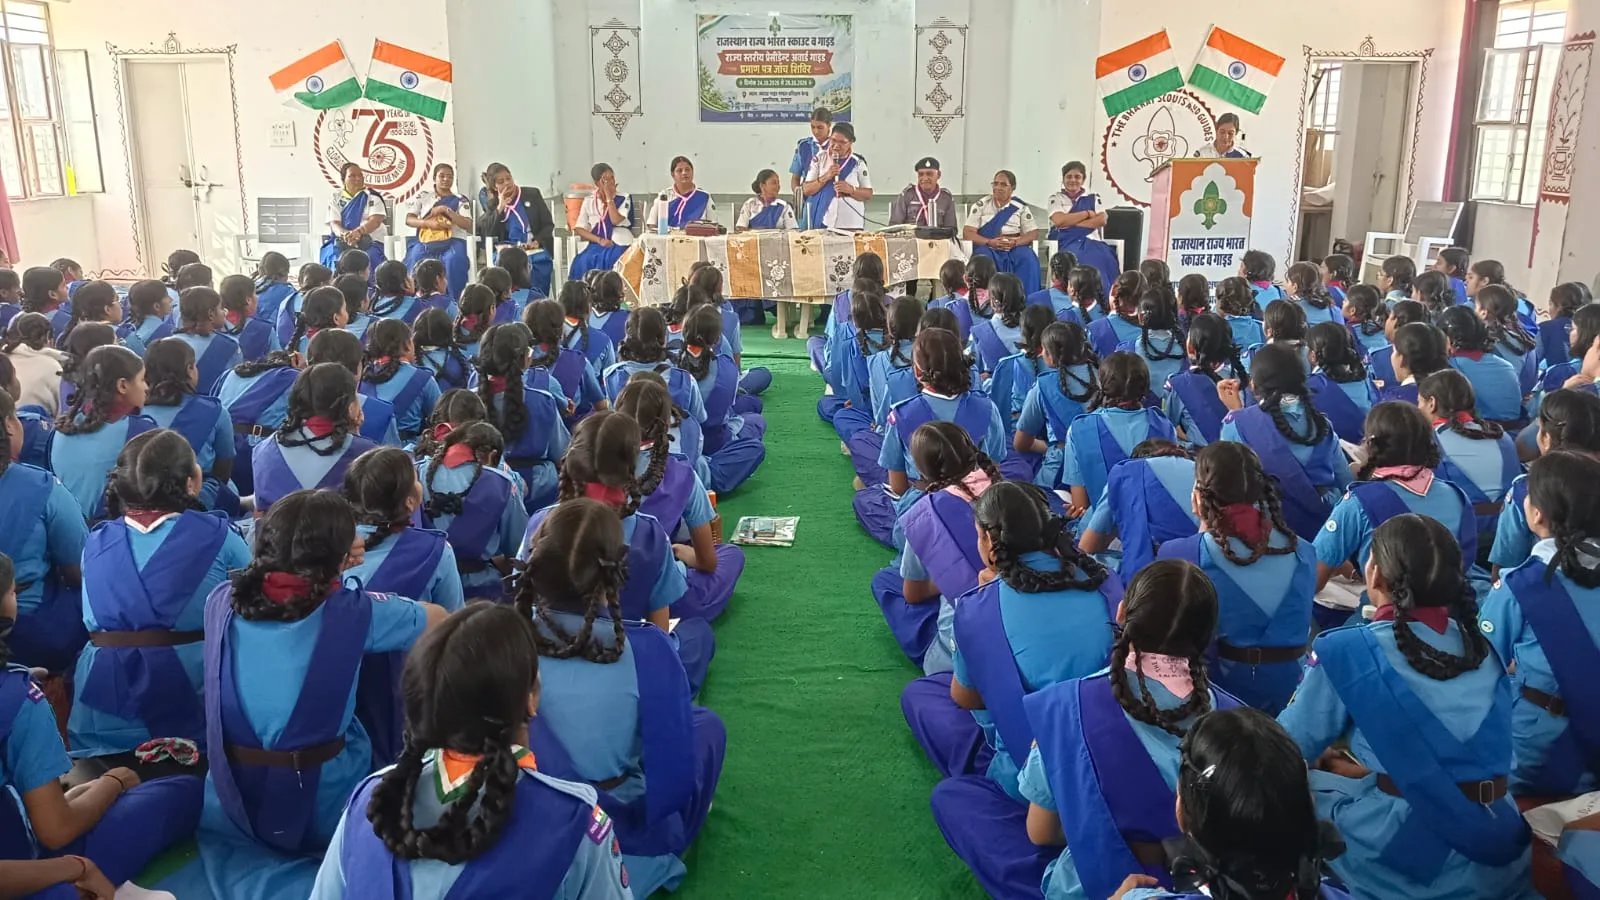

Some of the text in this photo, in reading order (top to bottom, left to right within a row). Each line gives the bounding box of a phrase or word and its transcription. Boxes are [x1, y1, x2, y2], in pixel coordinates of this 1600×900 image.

[717, 37, 835, 47] राजस्थान राज्य भारत स्काउट व गाइड
[725, 53, 742, 62] राज्य
[743, 51, 764, 62] स्तरीय
[791, 51, 809, 62] अवार्ड
[810, 53, 826, 63] गाइड
[740, 64, 760, 74] प्रमाण
[761, 64, 772, 74] पत्र
[790, 63, 812, 74] शिविर
[386, 109, 404, 118] YEARS
[1112, 120, 1126, 138] THE
[1157, 93, 1188, 106] SCOUTS
[1186, 102, 1200, 116] AND
[1197, 113, 1214, 142] GUIDES
[352, 109, 415, 190] 75
[1172, 237, 1246, 250] राजस्थान राज्य भारत
[1181, 254, 1234, 268] स्काउट व गाइड
